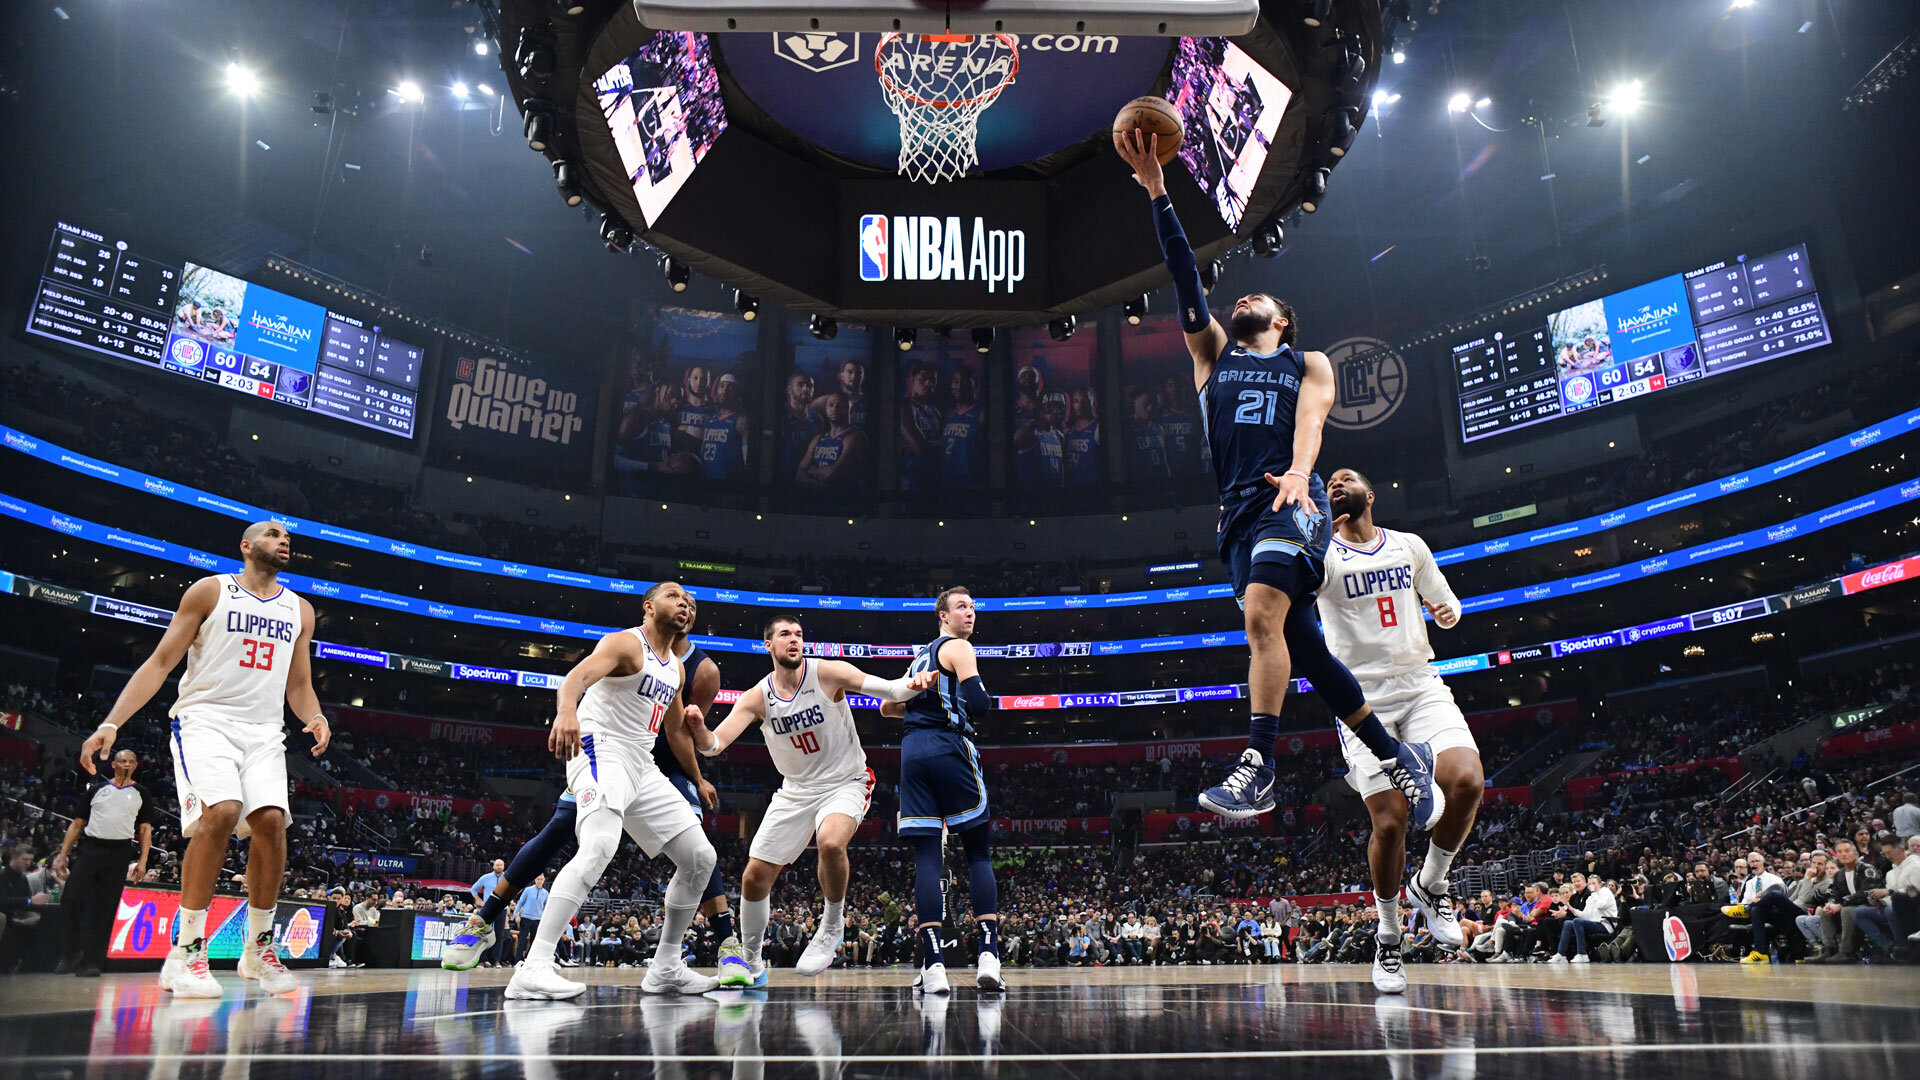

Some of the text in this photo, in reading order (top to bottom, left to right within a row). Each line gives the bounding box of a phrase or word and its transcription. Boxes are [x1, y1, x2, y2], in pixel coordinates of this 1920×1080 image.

[884, 53, 1009, 75] ARENA
[58, 222, 104, 242] TEAM STATS
[98, 250, 111, 259] 26
[893, 216, 1025, 293] NBA App
[1752, 252, 1800, 272] AST 15
[98, 264, 105, 272] 7
[122, 273, 135, 282] BLK
[126, 260, 173, 280] AST 10
[1685, 262, 1725, 279] TEAM STATS
[1727, 272, 1738, 281] 13
[1793, 267, 1799, 275] 1
[92, 278, 104, 287] 19
[1732, 286, 1738, 294] 0
[1758, 280, 1803, 299] STL 5
[119, 287, 164, 306] STL 3
[1732, 298, 1744, 307] 13
[42, 289, 62, 299] FIELD
[63, 295, 86, 306] GOALS
[140, 318, 167, 331] 50.0%
[328, 312, 363, 327] TEAM STATS
[1618, 302, 1678, 334] HAWAIIAN
[54, 308, 74, 318] FIELD
[75, 313, 97, 324] GOALS
[137, 331, 164, 345] 46.2%
[252, 310, 312, 340] HAWAIIAN
[1700, 302, 1816, 339] FIELD GOALS 52.5%
[35, 318, 161, 359] FREE THROWS 14-15 93.3%
[1717, 339, 1733, 348] FIELD
[1734, 334, 1754, 344] GOALS
[1791, 316, 1820, 329] 42.9%
[1707, 329, 1823, 366] FREE THROWS 75.0%
[215, 352, 270, 379] 60 54
[1602, 359, 1656, 386] 60 54
[206, 369, 218, 380] 2nd
[226, 375, 253, 391] 2:03
[262, 387, 270, 395] 14
[473, 358, 577, 414] Give no
[1218, 370, 1300, 393] GRIZZLIES
[1600, 393, 1611, 401] 2nd
[1618, 383, 1645, 398] 2:03
[447, 383, 582, 444] Quarter
[1235, 390, 1278, 426] 21
[704, 444, 717, 461] 23
[1819, 500, 1876, 524] gohawaii.com/malama
[107, 533, 165, 552] gohawaii.com/malama
[1344, 564, 1411, 599] CLIPPERS
[106, 602, 159, 619] The LA Clippers
[1377, 596, 1398, 628] 8
[1712, 606, 1744, 623] 8:07
[227, 610, 294, 643] CLIPPERS
[1641, 621, 1684, 637] crypto.com
[849, 646, 864, 656] 60
[877, 647, 908, 656] Clippers
[1016, 647, 1030, 657] 54
[1561, 634, 1612, 653] Spectrum
[240, 638, 275, 672] 33
[1512, 649, 1542, 660] TOYOTA
[460, 666, 509, 681] Spectrum
[525, 676, 544, 685] UCLA
[637, 674, 677, 706] CLIPPER
[1195, 689, 1232, 698] crypto.com
[1077, 695, 1115, 706] DELTA
[648, 704, 664, 734] 10
[771, 704, 824, 735] CLIPPERS
[790, 731, 820, 755] 40
[378, 859, 404, 869] ULTRA
[111, 898, 157, 953] 76
